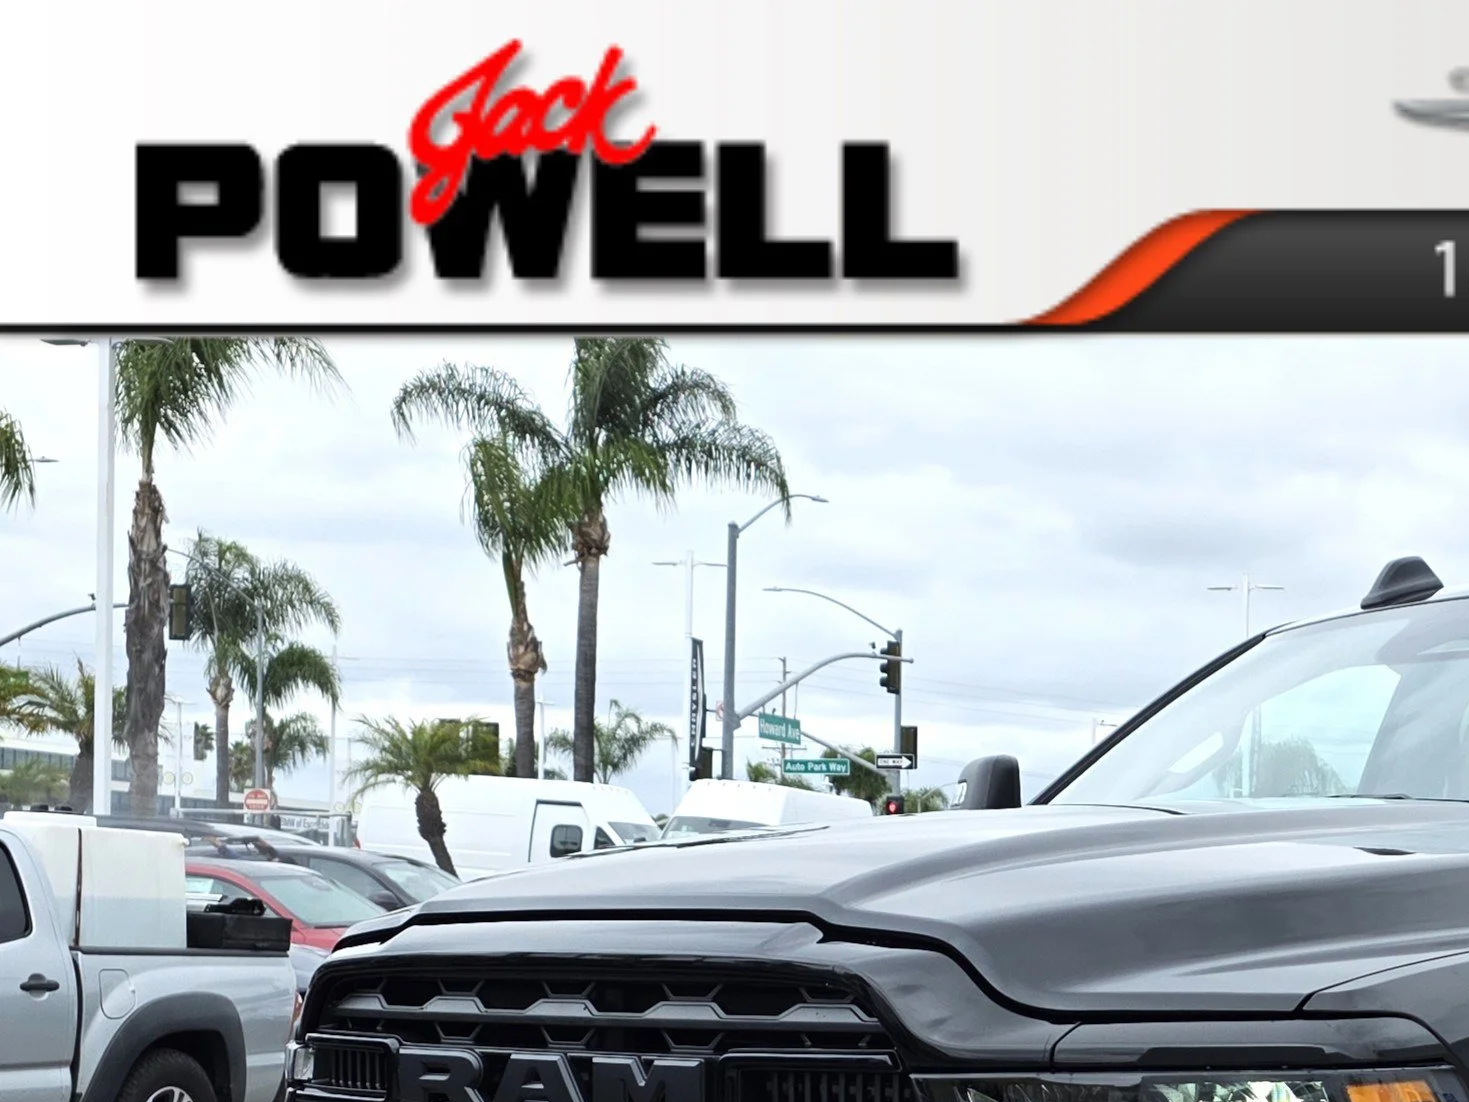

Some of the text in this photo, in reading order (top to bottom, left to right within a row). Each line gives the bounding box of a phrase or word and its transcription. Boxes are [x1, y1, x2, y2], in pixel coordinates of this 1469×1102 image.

[760, 718, 800, 740] Howard Ave
[785, 761, 847, 773] Auto Park Way
